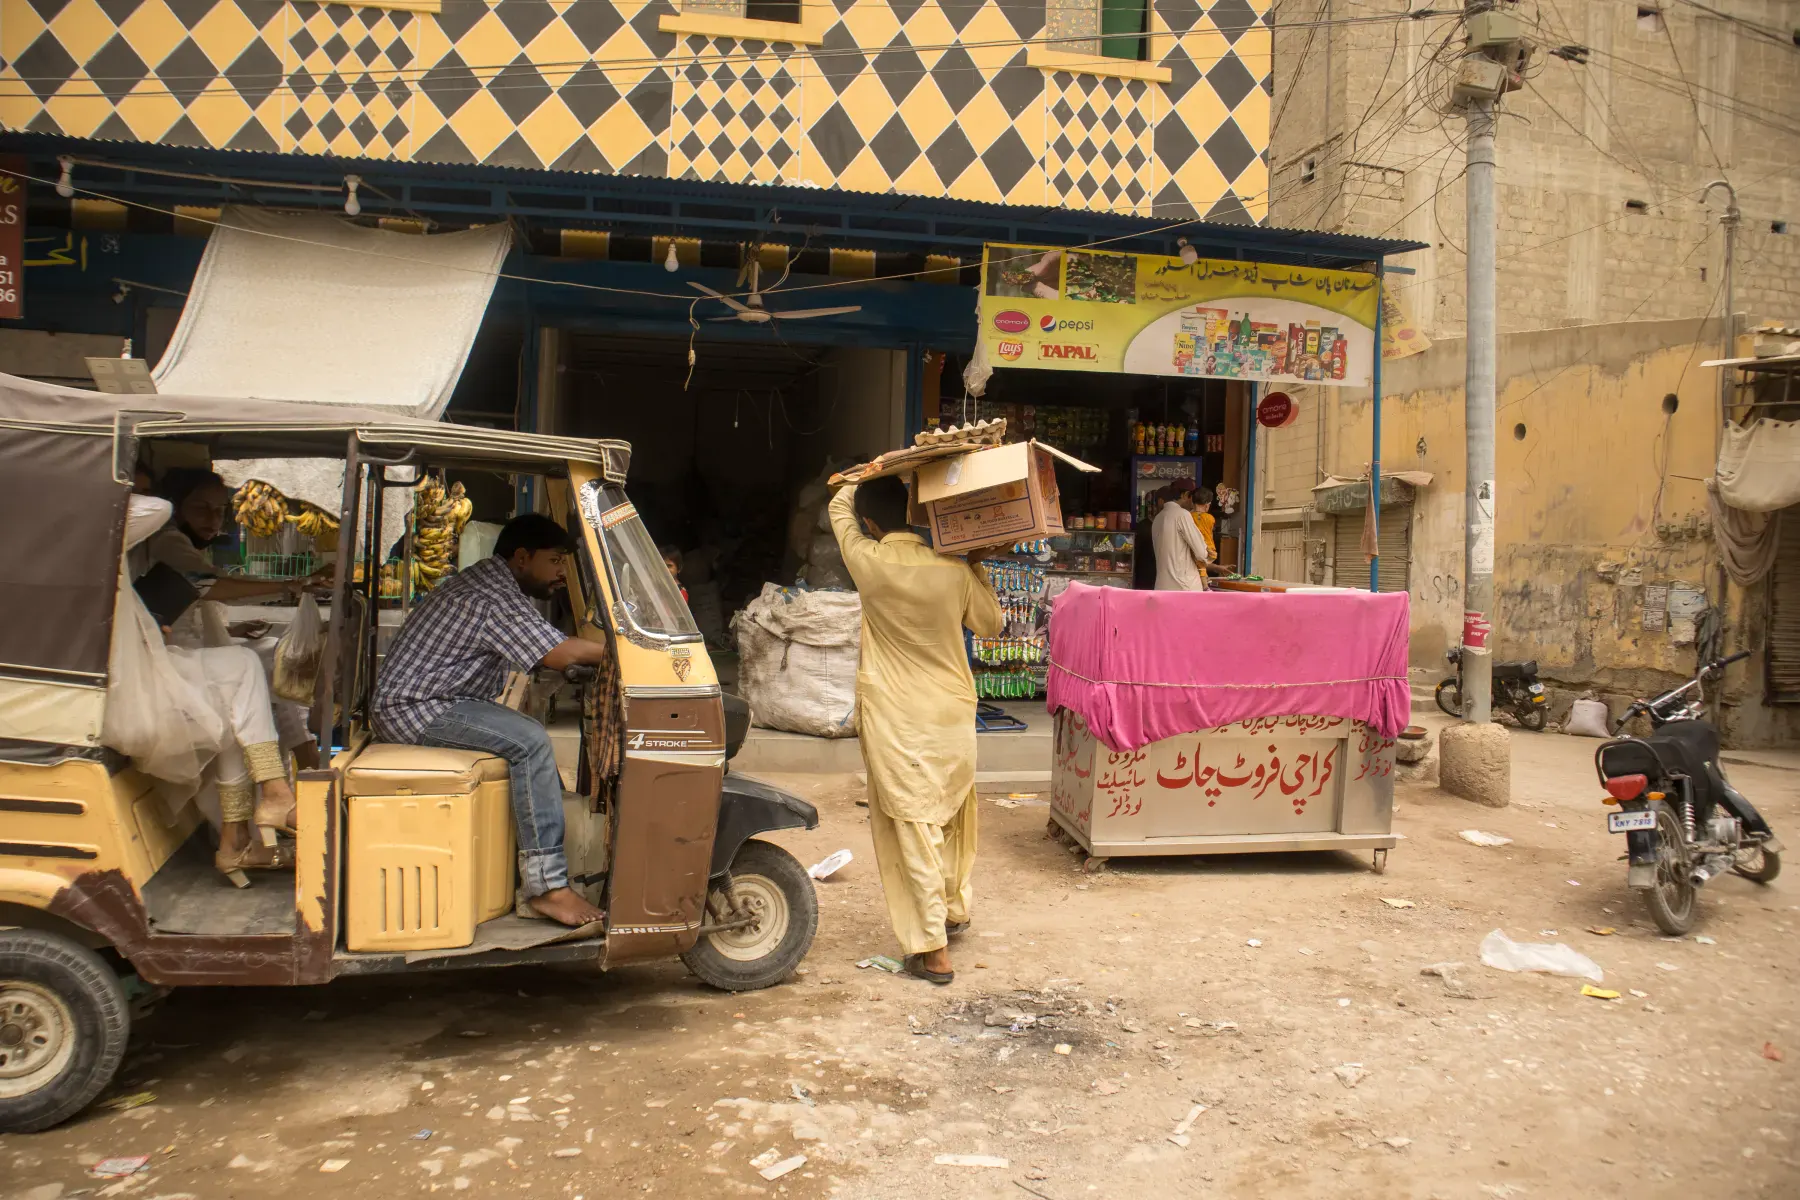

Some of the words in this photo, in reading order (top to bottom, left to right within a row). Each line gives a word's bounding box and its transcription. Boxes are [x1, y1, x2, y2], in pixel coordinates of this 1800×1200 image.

[0, 204, 18, 225] S
[1197, 260, 1240, 281] جنرل
[1261, 271, 1313, 292] شاپ
[1316, 275, 1332, 297] پان
[1059, 319, 1094, 331] pepsi
[1040, 344, 1097, 360] TAPAL
[1159, 466, 1189, 477] pepsi
[628, 733, 645, 750] 4
[645, 739, 687, 748] STROKE
[1156, 742, 1223, 808] چاٹ
[1216, 743, 1280, 801] فروٹ
[1279, 744, 1338, 815] کراچی
[1615, 820, 1630, 828] KNY
[618, 926, 661, 935] CNG
